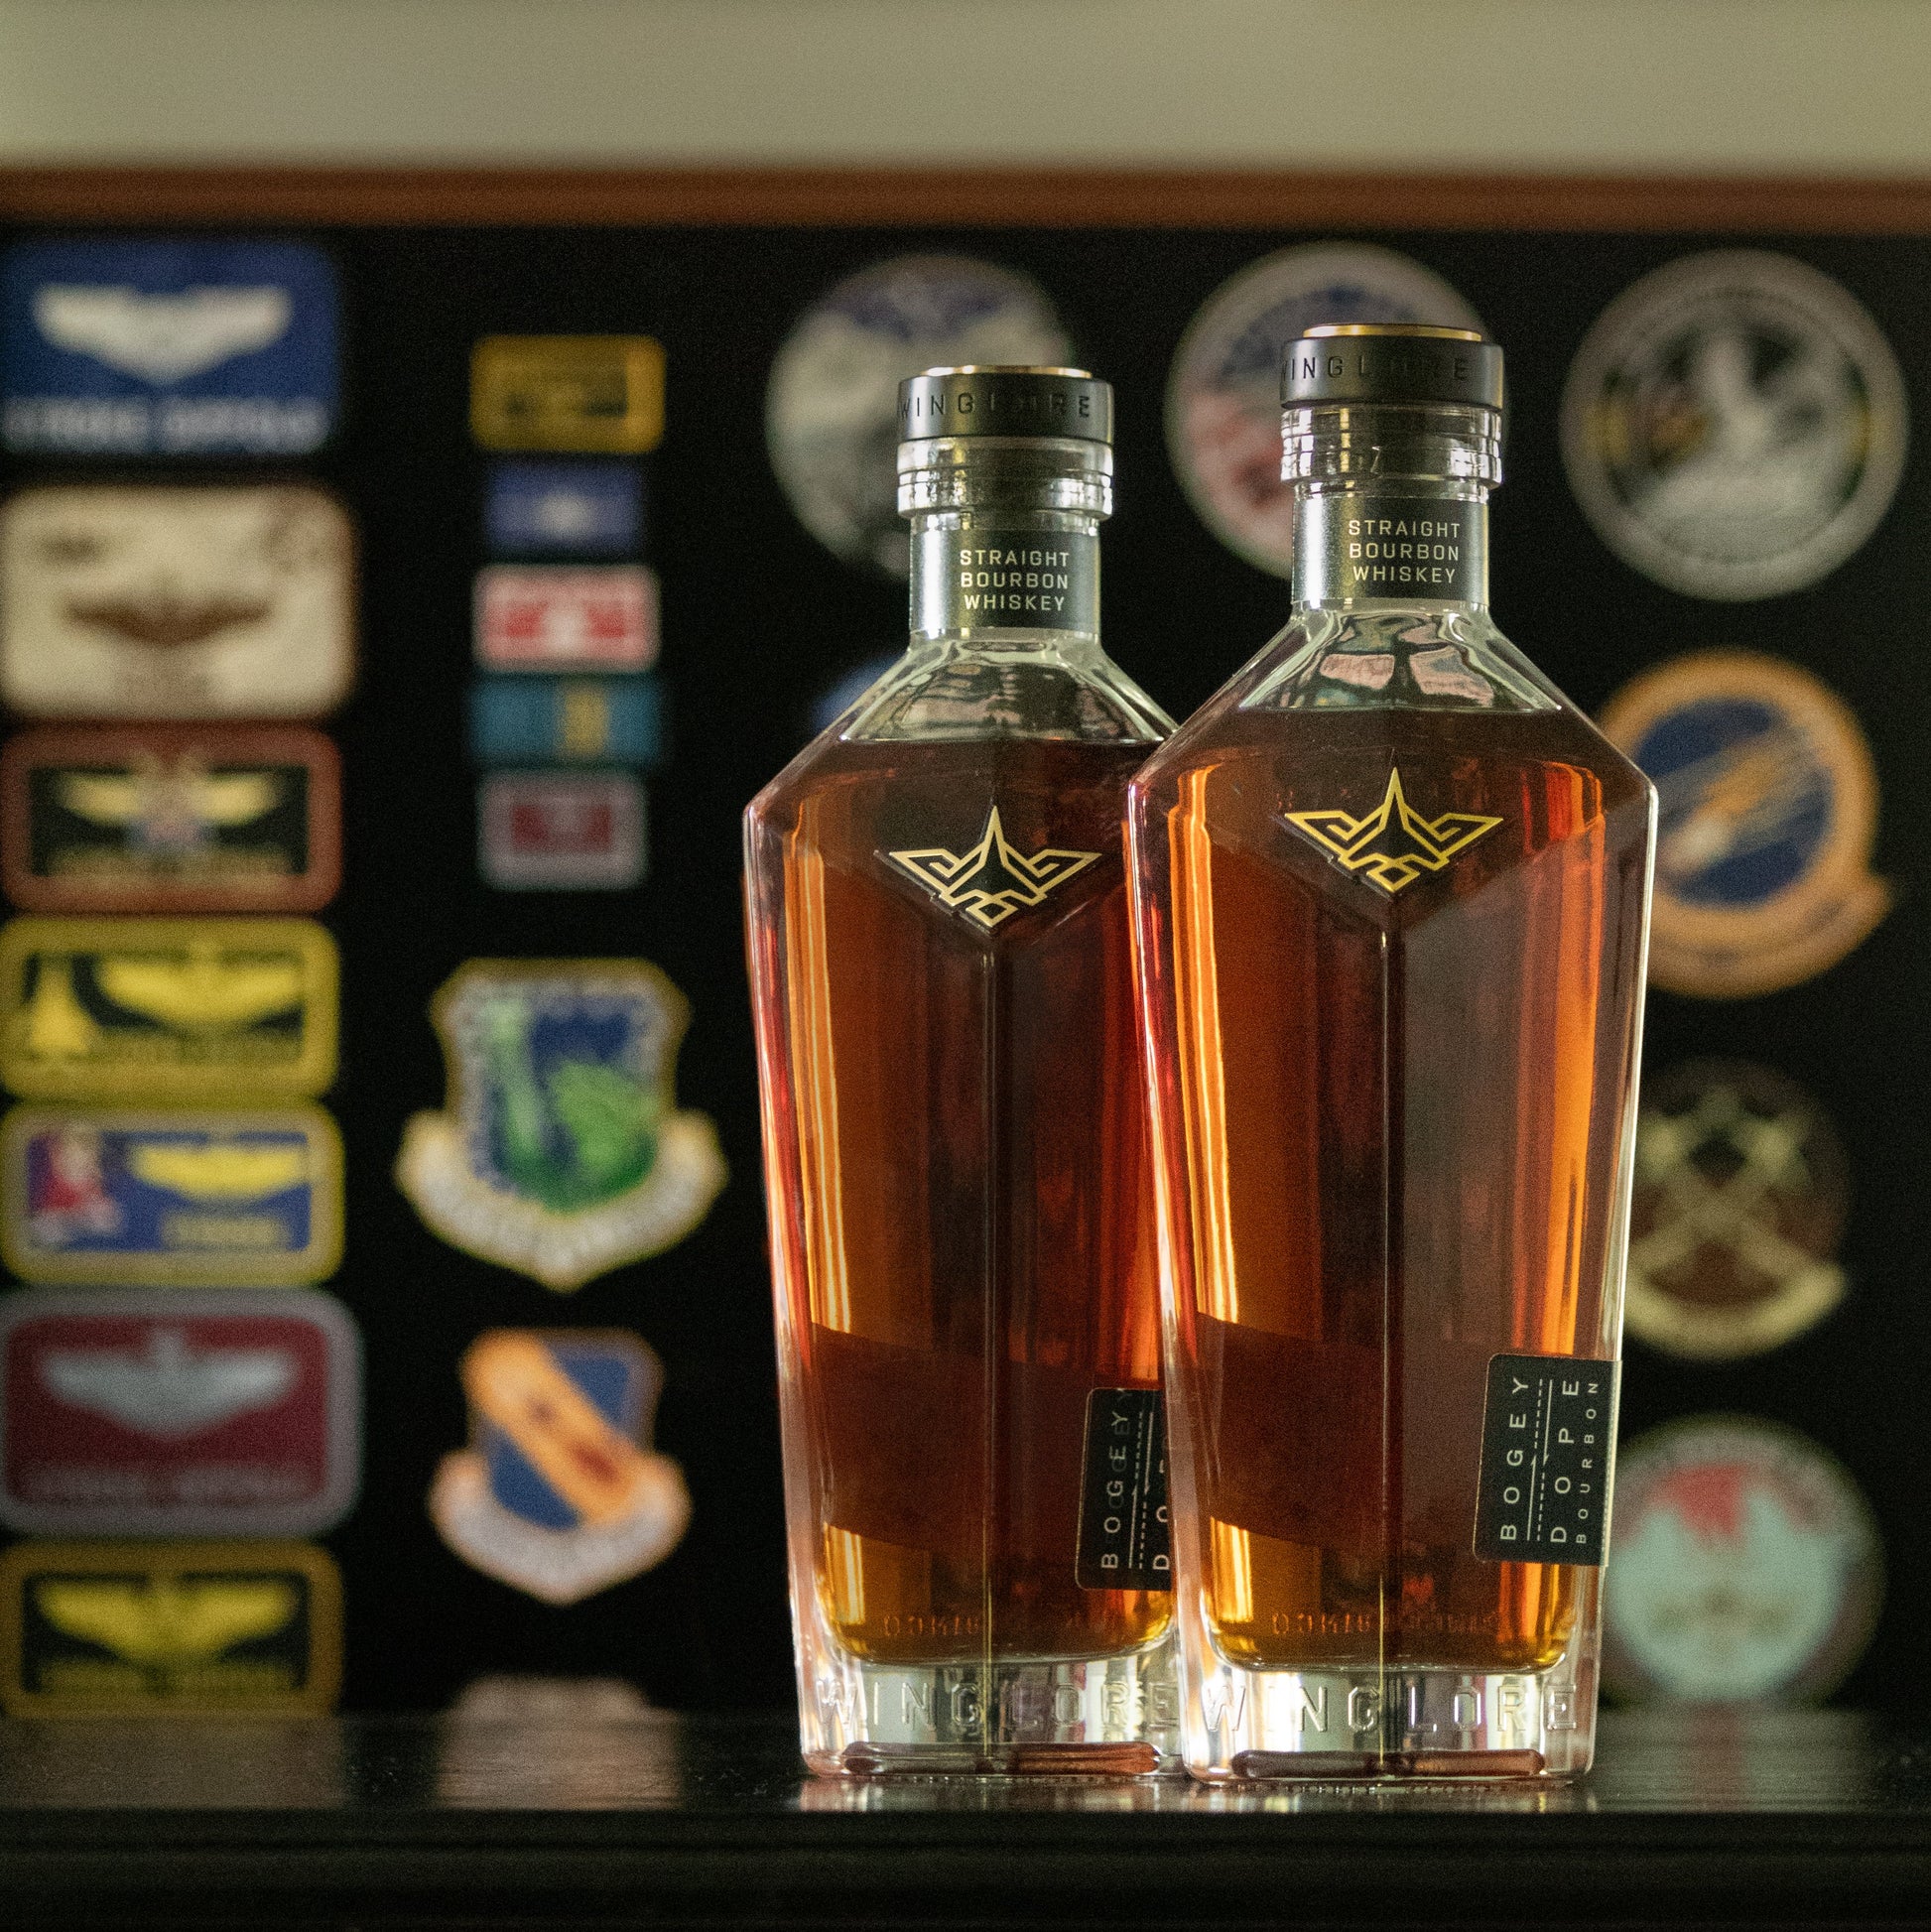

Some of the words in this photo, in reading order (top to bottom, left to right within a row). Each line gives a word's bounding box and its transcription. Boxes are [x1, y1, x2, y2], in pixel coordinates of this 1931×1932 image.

[1349, 520, 1460, 538] STRAIGHT
[960, 549, 1070, 567] STRAIGHT
[1350, 543, 1459, 561] BOURBON
[961, 573, 1068, 589] BOURBON
[1352, 566, 1456, 583] WHISKEY
[964, 594, 1065, 611] WHISKEY
[1499, 1376, 1529, 1541] BOGEY
[1550, 1380, 1580, 1543] DOPE
[1575, 1382, 1599, 1544] BOURBON
[1100, 1410, 1128, 1570] BOGEY
[1203, 1684, 1578, 1734] WINGLORE
